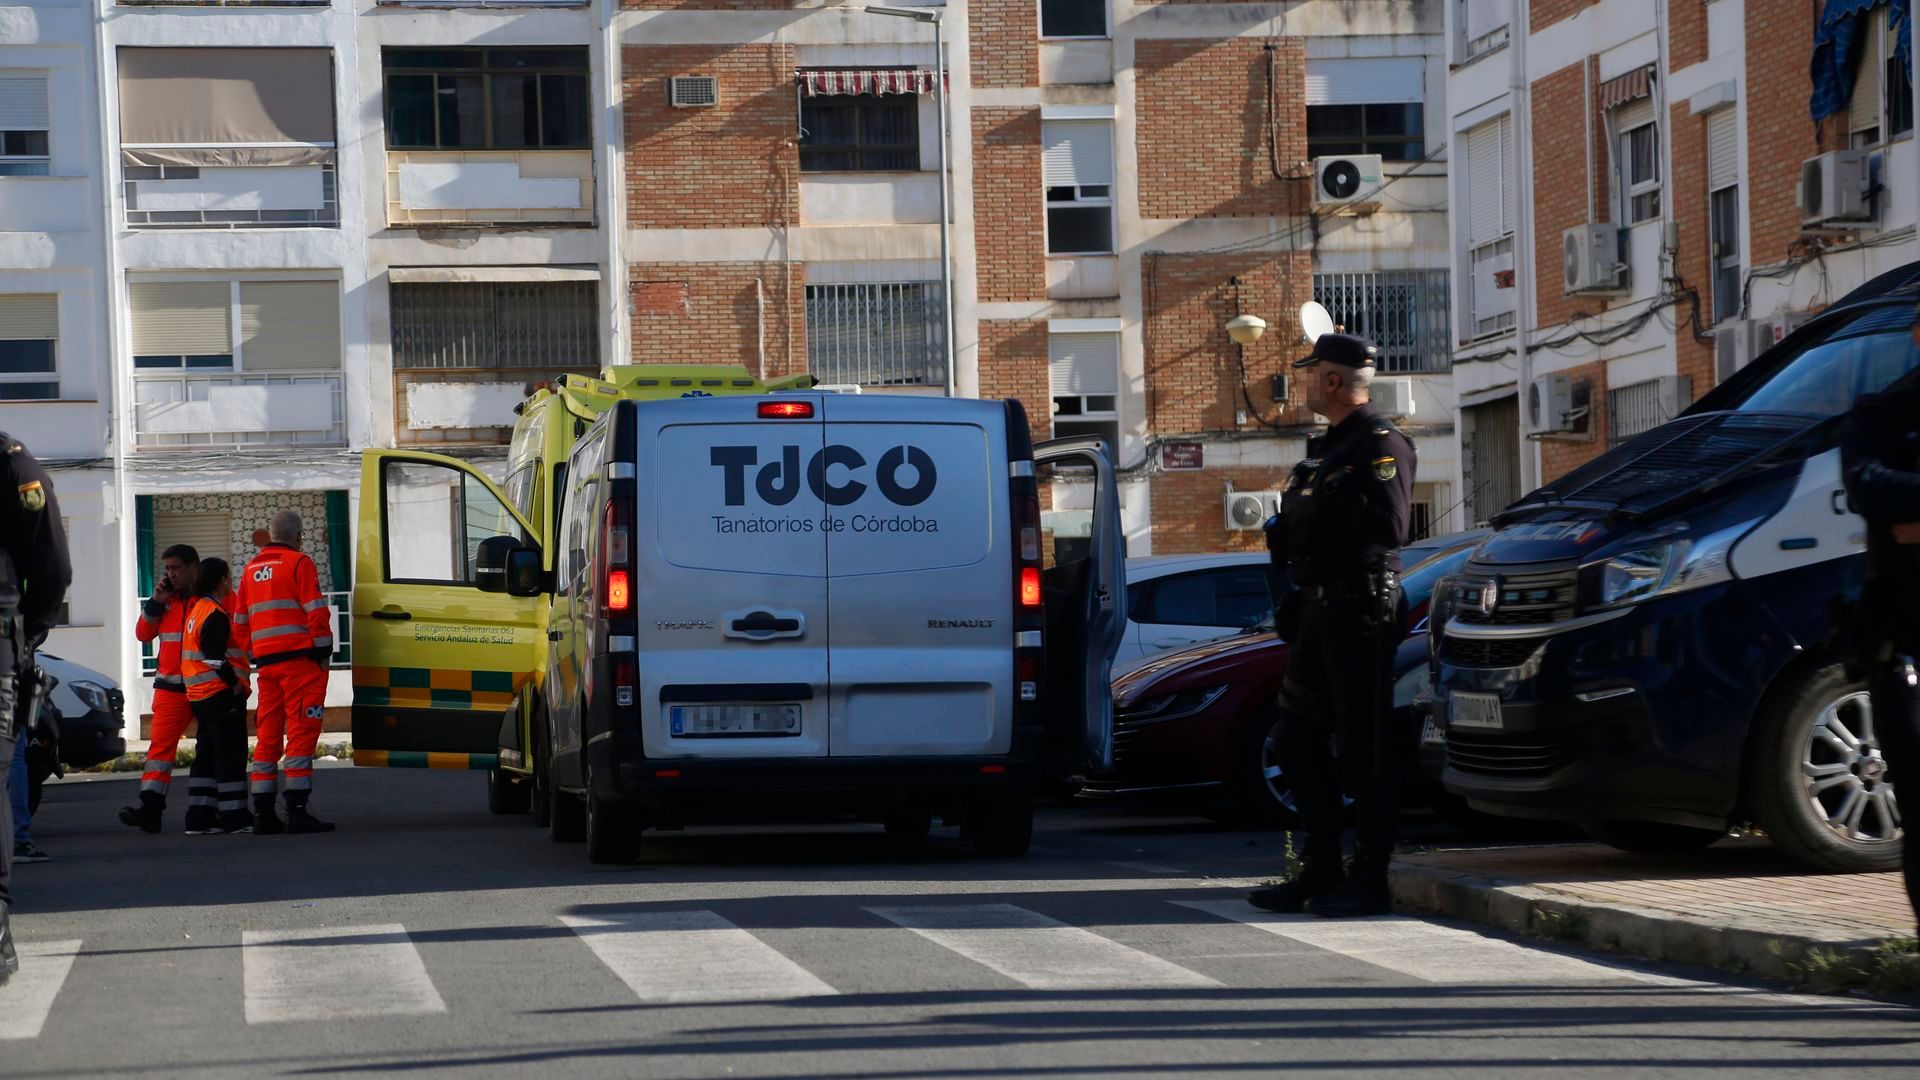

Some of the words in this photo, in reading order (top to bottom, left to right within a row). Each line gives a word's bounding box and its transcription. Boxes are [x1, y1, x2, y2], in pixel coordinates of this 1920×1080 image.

[711, 515, 814, 534] Tanatorios
[820, 515, 845, 533] de
[851, 515, 939, 533] Córdoba
[253, 565, 273, 582] 061
[415, 623, 460, 633] Emergencias
[462, 625, 499, 634] Sanitarias
[655, 620, 714, 630] TRAFIC
[927, 618, 996, 629] RENAULT
[415, 633, 444, 642] Servicio
[447, 634, 478, 643] Andaluz
[480, 635, 490, 644] de
[492, 636, 514, 645] Salud
